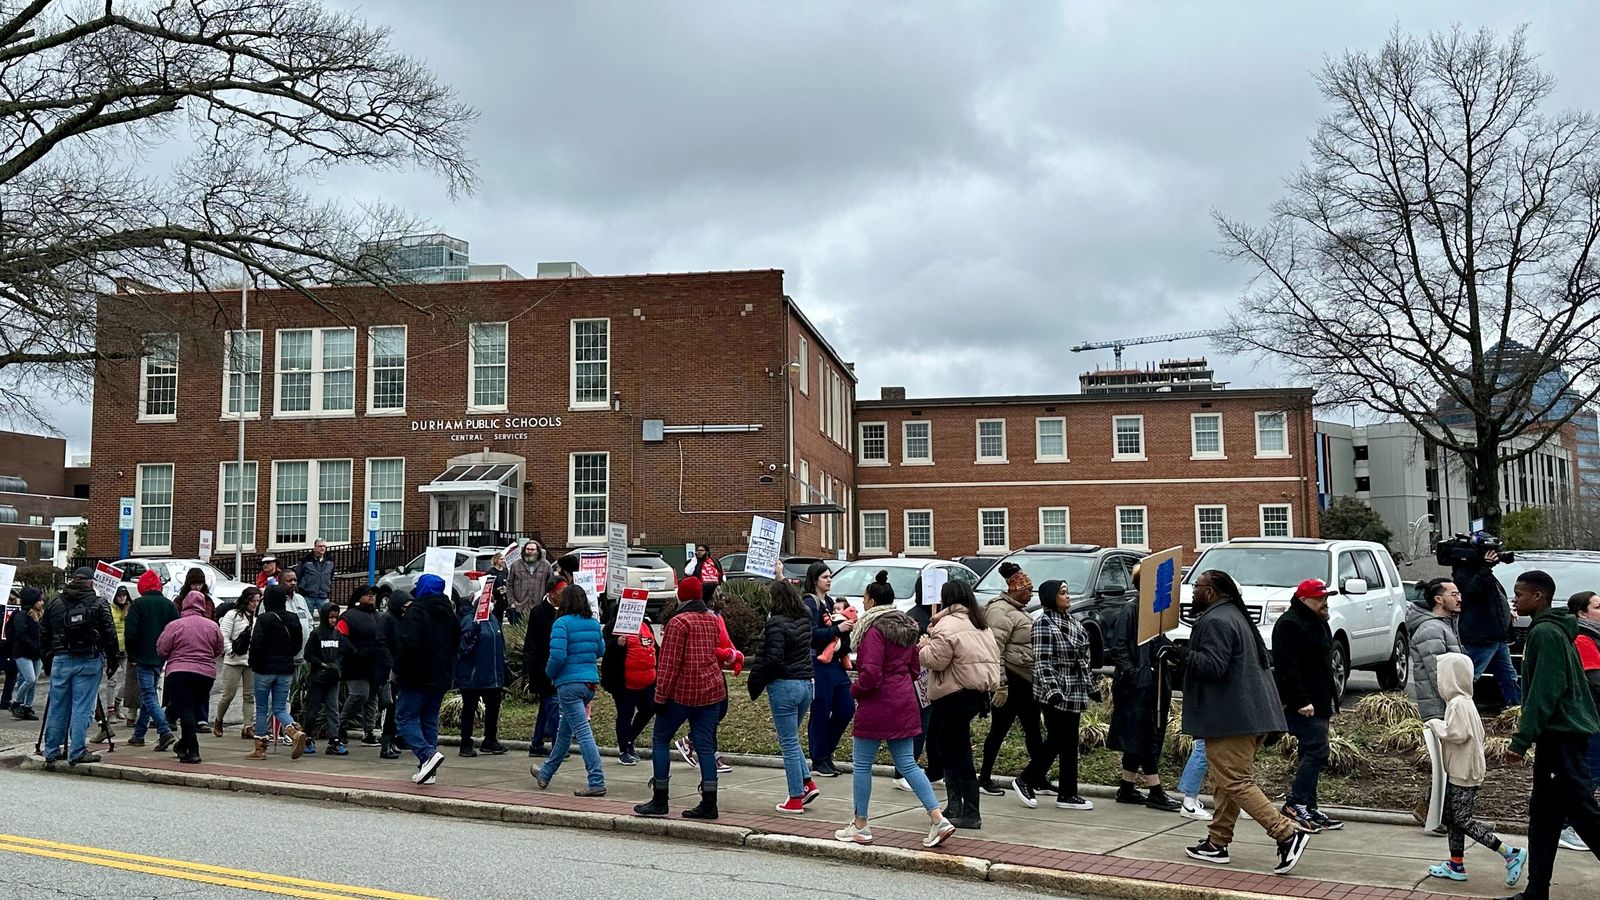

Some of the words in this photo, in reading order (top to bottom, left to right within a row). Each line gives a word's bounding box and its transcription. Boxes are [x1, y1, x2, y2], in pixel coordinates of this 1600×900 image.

[411, 420, 463, 431] DURHAM
[466, 419, 500, 429] PUBLIC
[505, 417, 562, 428] SCHOOLS
[95, 573, 119, 586] RESPECT
[620, 603, 645, 612] RESPECT
